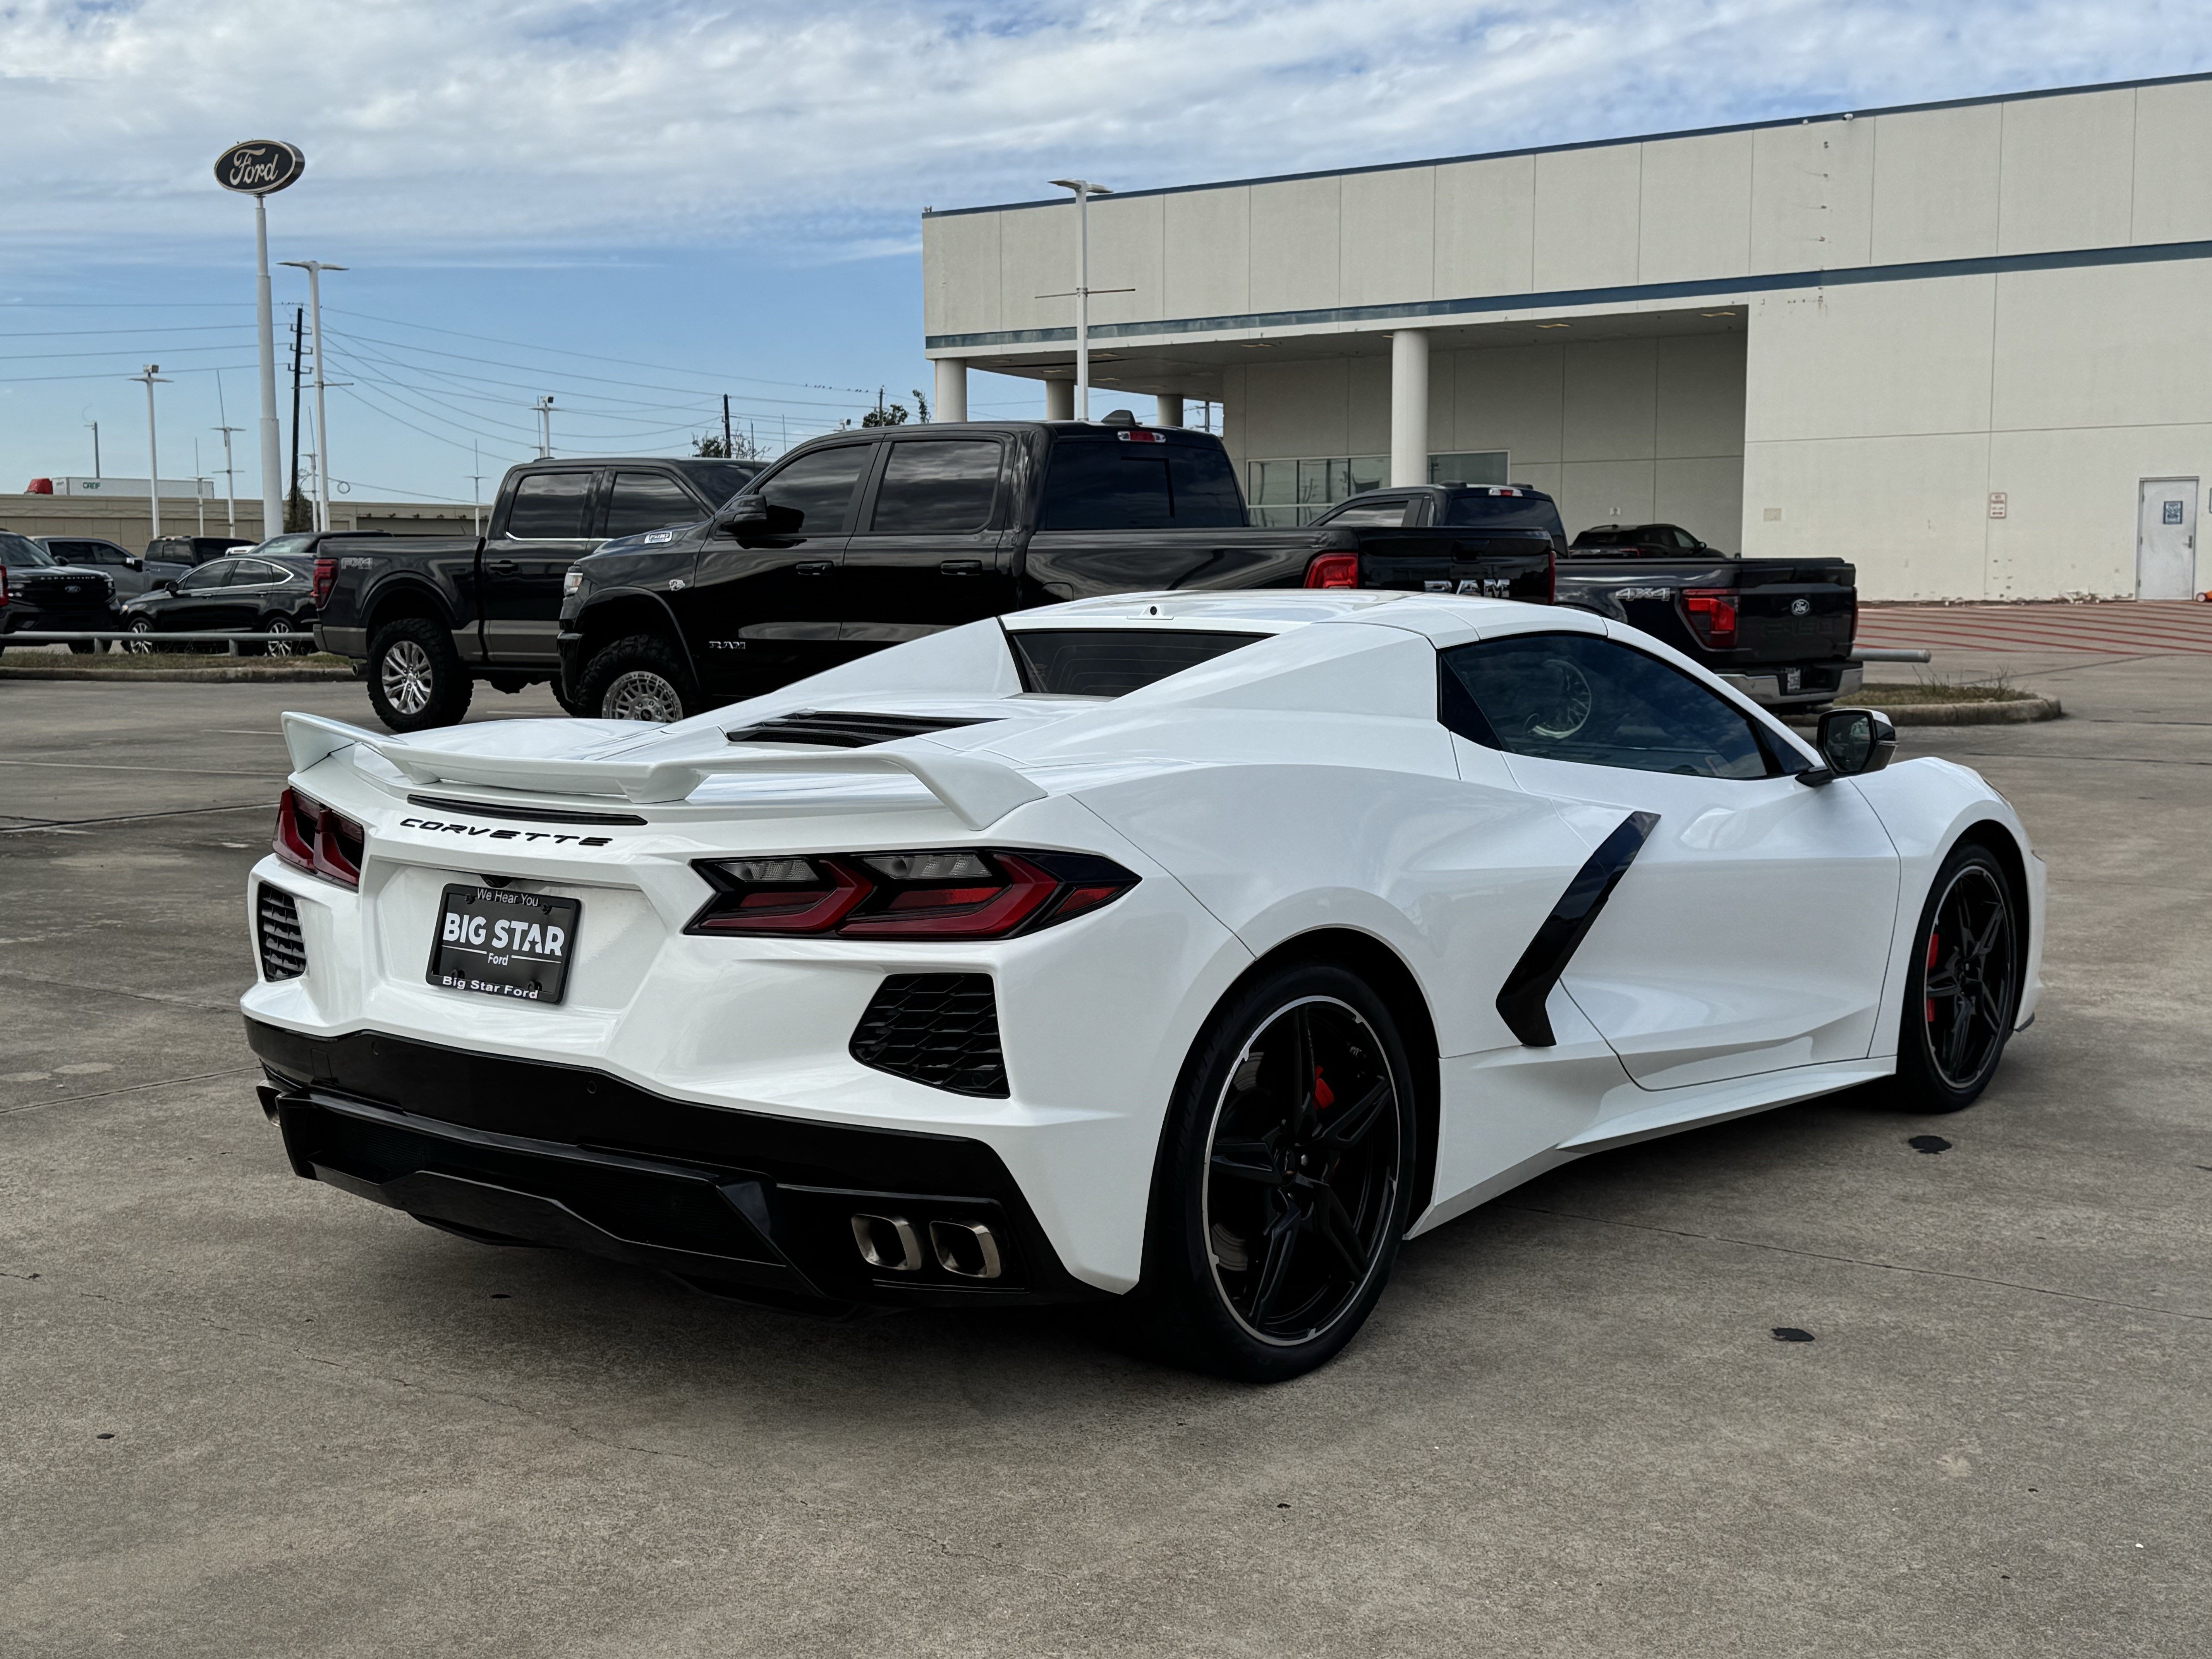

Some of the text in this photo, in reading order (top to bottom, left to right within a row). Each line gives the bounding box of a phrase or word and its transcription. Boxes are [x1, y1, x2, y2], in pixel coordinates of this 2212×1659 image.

[230, 148, 278, 185] Ford
[341, 557, 373, 570] FX4
[1424, 579, 1510, 598] RAM
[709, 641, 746, 649] RAM
[400, 818, 613, 847] CORVETTE
[477, 888, 539, 907] We Hear You
[442, 912, 565, 957] BIG STAR
[488, 953, 508, 966] Ford
[442, 975, 539, 999] Big Star Ford
